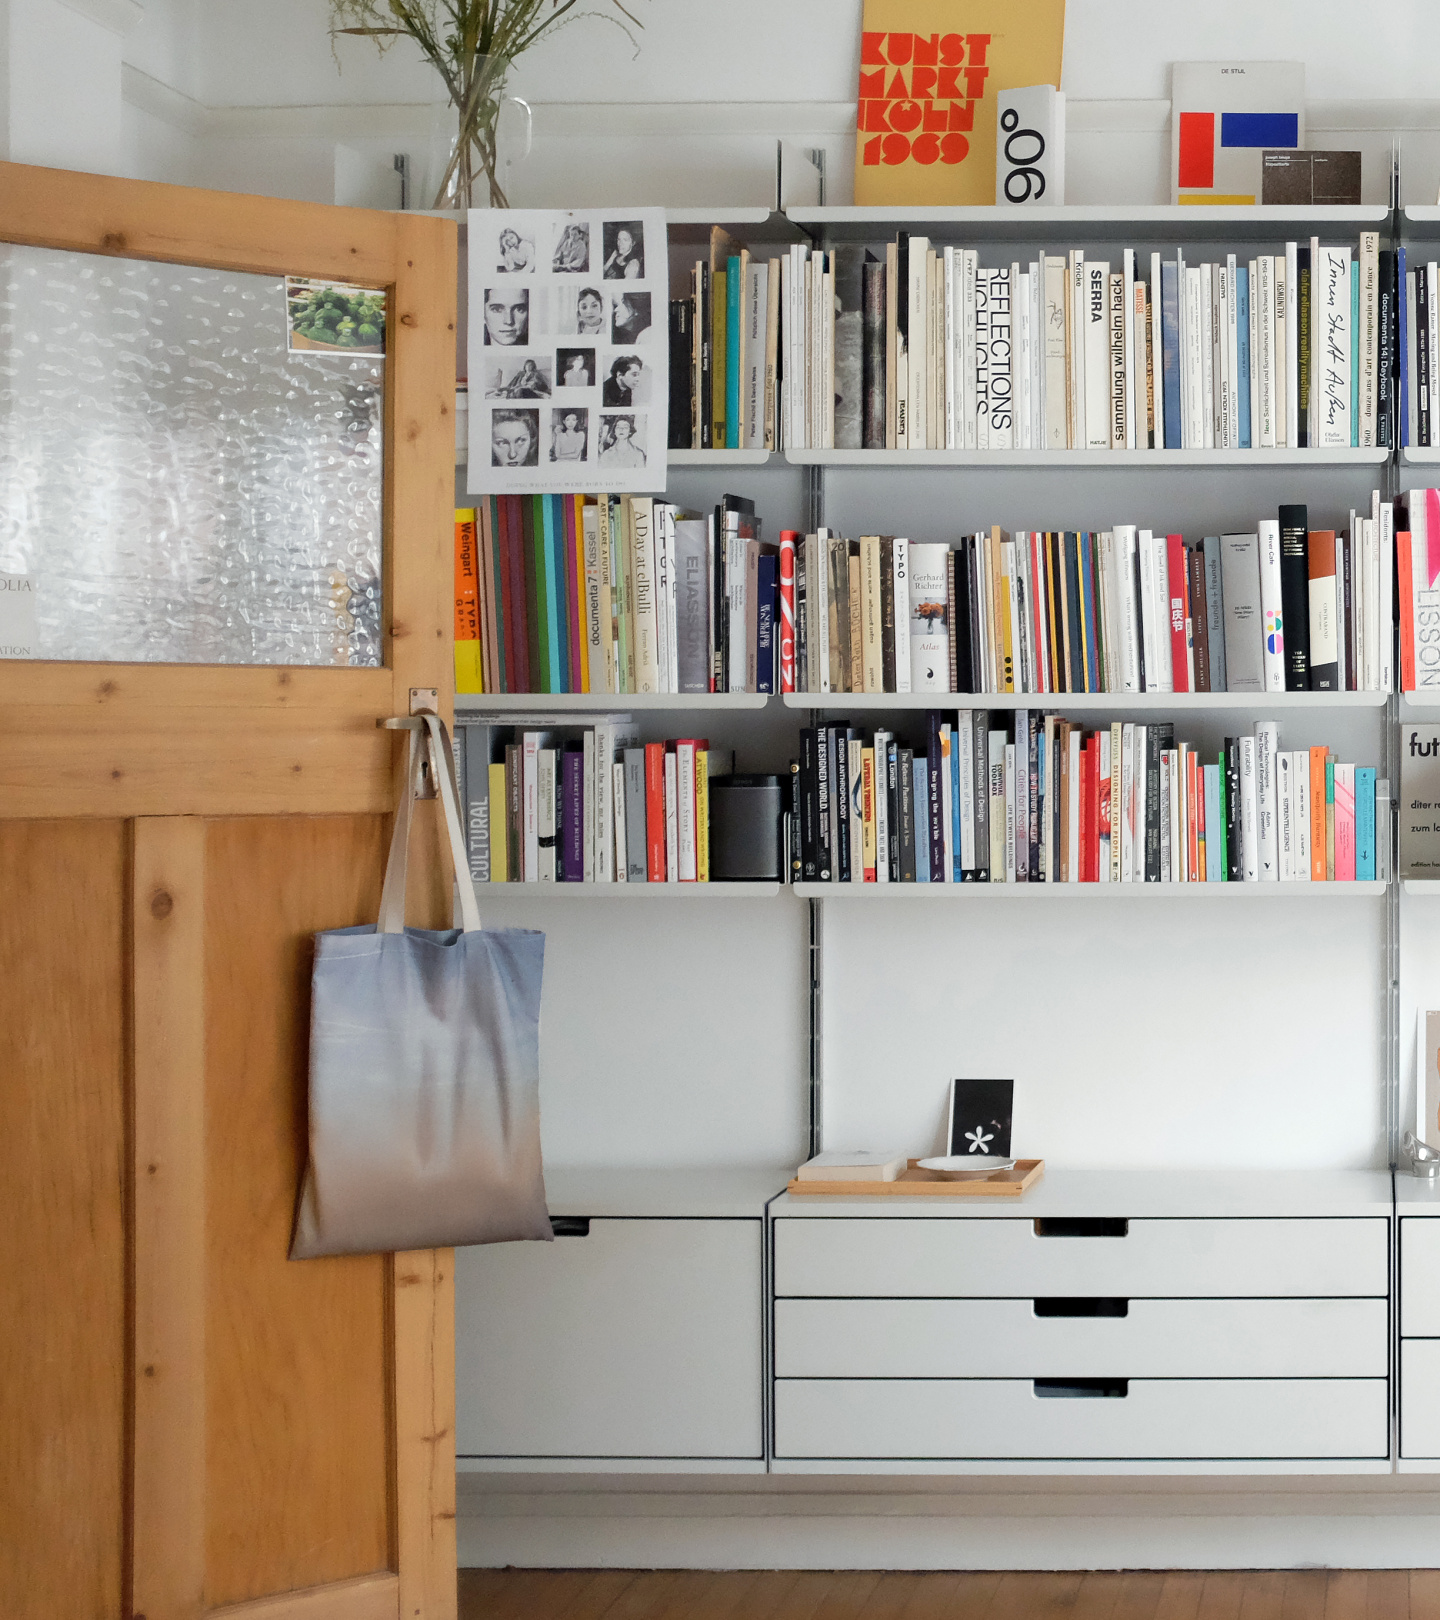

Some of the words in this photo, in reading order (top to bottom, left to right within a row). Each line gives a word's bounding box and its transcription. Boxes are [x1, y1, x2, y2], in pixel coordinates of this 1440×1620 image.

[861, 32, 991, 66] KUNST
[859, 67, 989, 99] MARKT
[863, 133, 969, 165] 1969
[1091, 270, 1102, 323] SERRA
[1111, 280, 1122, 311] hack
[1300, 269, 1308, 295] olafur
[1327, 253, 1345, 306] Innen
[1365, 293, 1372, 301] en
[1300, 296, 1308, 334] eliasson
[1380, 293, 1389, 344] documenta
[991, 269, 1011, 429] REFLECTIONS
[1112, 316, 1122, 365] wilhelm
[1300, 336, 1308, 364] reality
[1327, 313, 1345, 363] Stadt
[1380, 347, 1389, 359] 14:
[1300, 365, 1308, 409] machines
[1325, 369, 1345, 424] Außen
[1380, 361, 1389, 400] Daybook
[1112, 371, 1124, 440] sammlung
[635, 512, 644, 521] A
[461, 523, 472, 576] Weingart
[587, 532, 596, 567] Kassel
[634, 526, 647, 551] Day
[637, 557, 645, 569] at
[637, 573, 650, 614] elBulli
[686, 556, 700, 658] ELIASSON
[590, 585, 600, 645] documenta
[1418, 589, 1440, 686] LISSON
[1017, 769, 1026, 791] Cities
[1017, 794, 1026, 806] for
[1411, 800, 1430, 809] diter
[471, 797, 489, 881] CULTURAL
[1017, 810, 1026, 839] People
